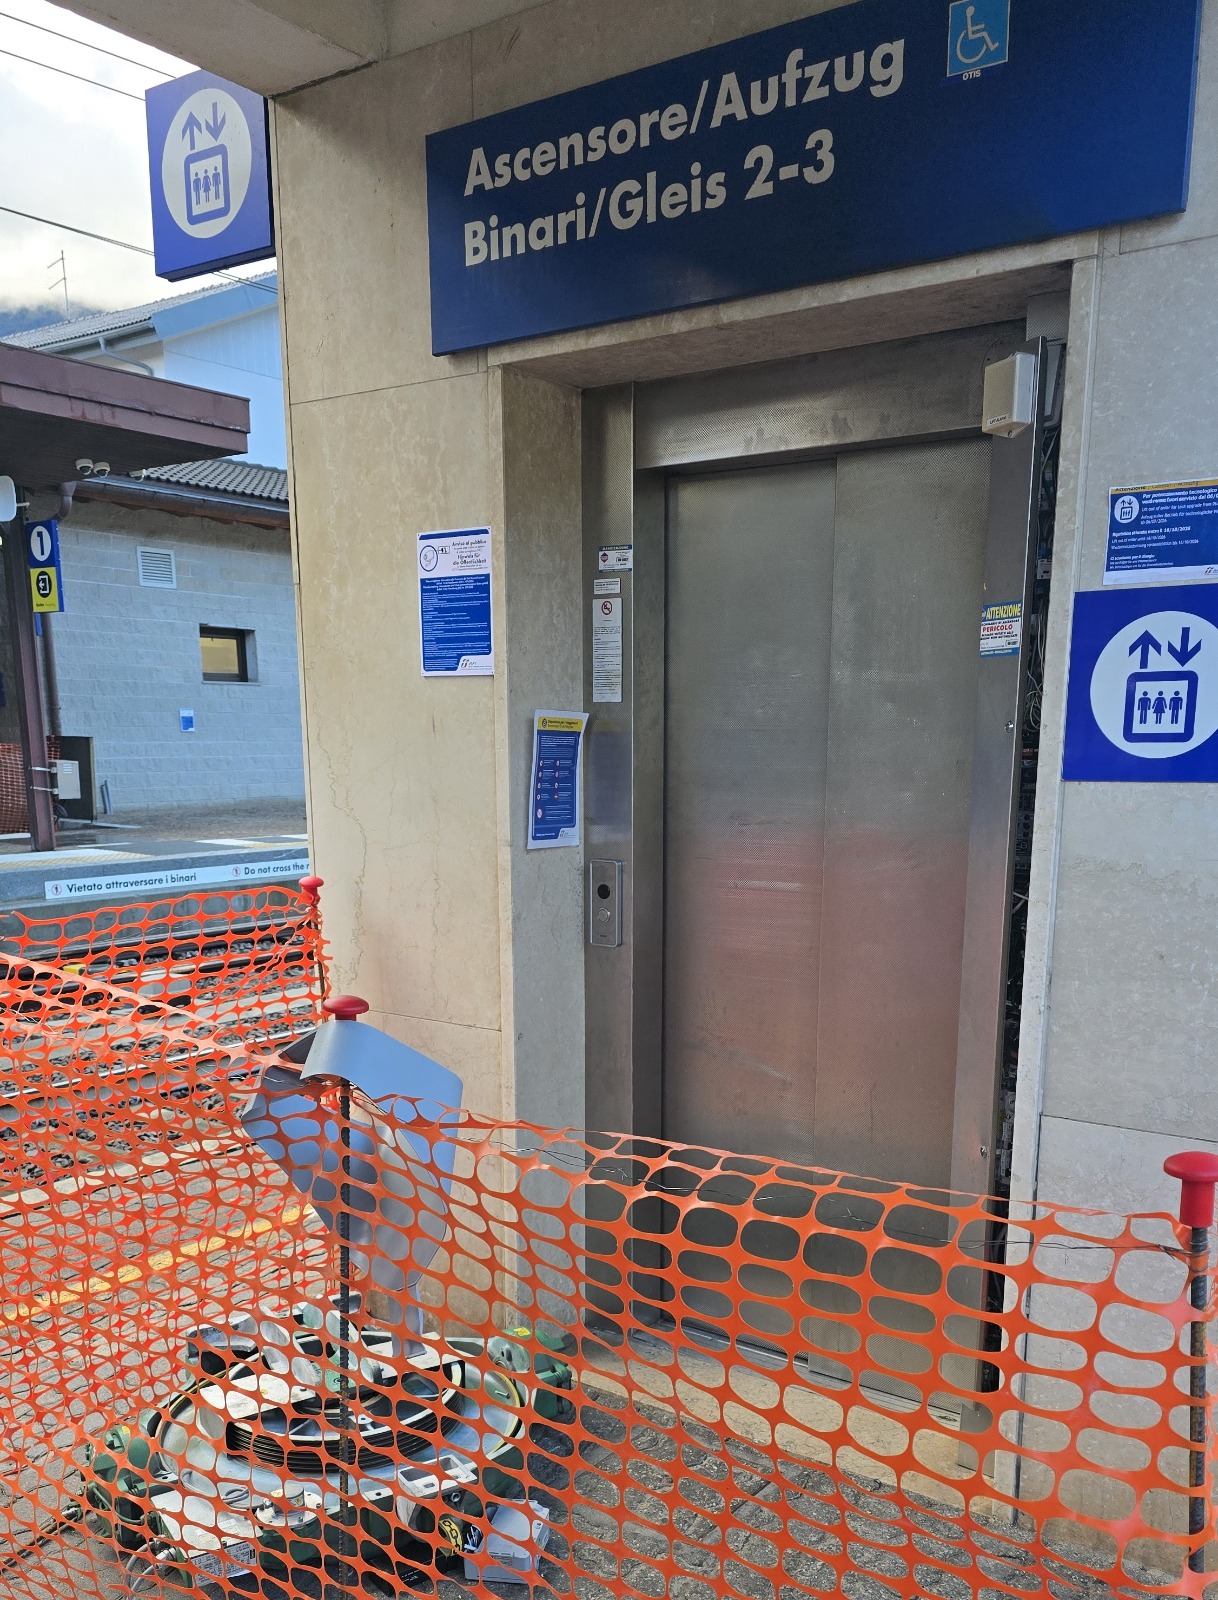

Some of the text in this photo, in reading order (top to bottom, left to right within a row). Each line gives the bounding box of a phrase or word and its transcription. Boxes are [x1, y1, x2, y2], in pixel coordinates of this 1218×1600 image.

[962, 69, 981, 81] OTIS
[464, 39, 905, 196] Ascensore/Aufzug
[464, 128, 835, 267] Binari/Gleis 2-3
[36, 531, 45, 556] 1
[986, 604, 1021, 619] ATTENZIONE
[983, 624, 1013, 632] PERICOLO
[244, 866, 256, 876] Do
[257, 865, 271, 875] not
[272, 864, 291, 873] cross
[292, 861, 305, 871] the
[66, 883, 103, 893] Vietato
[105, 877, 164, 890] attraversare
[170, 872, 197, 884] binari
